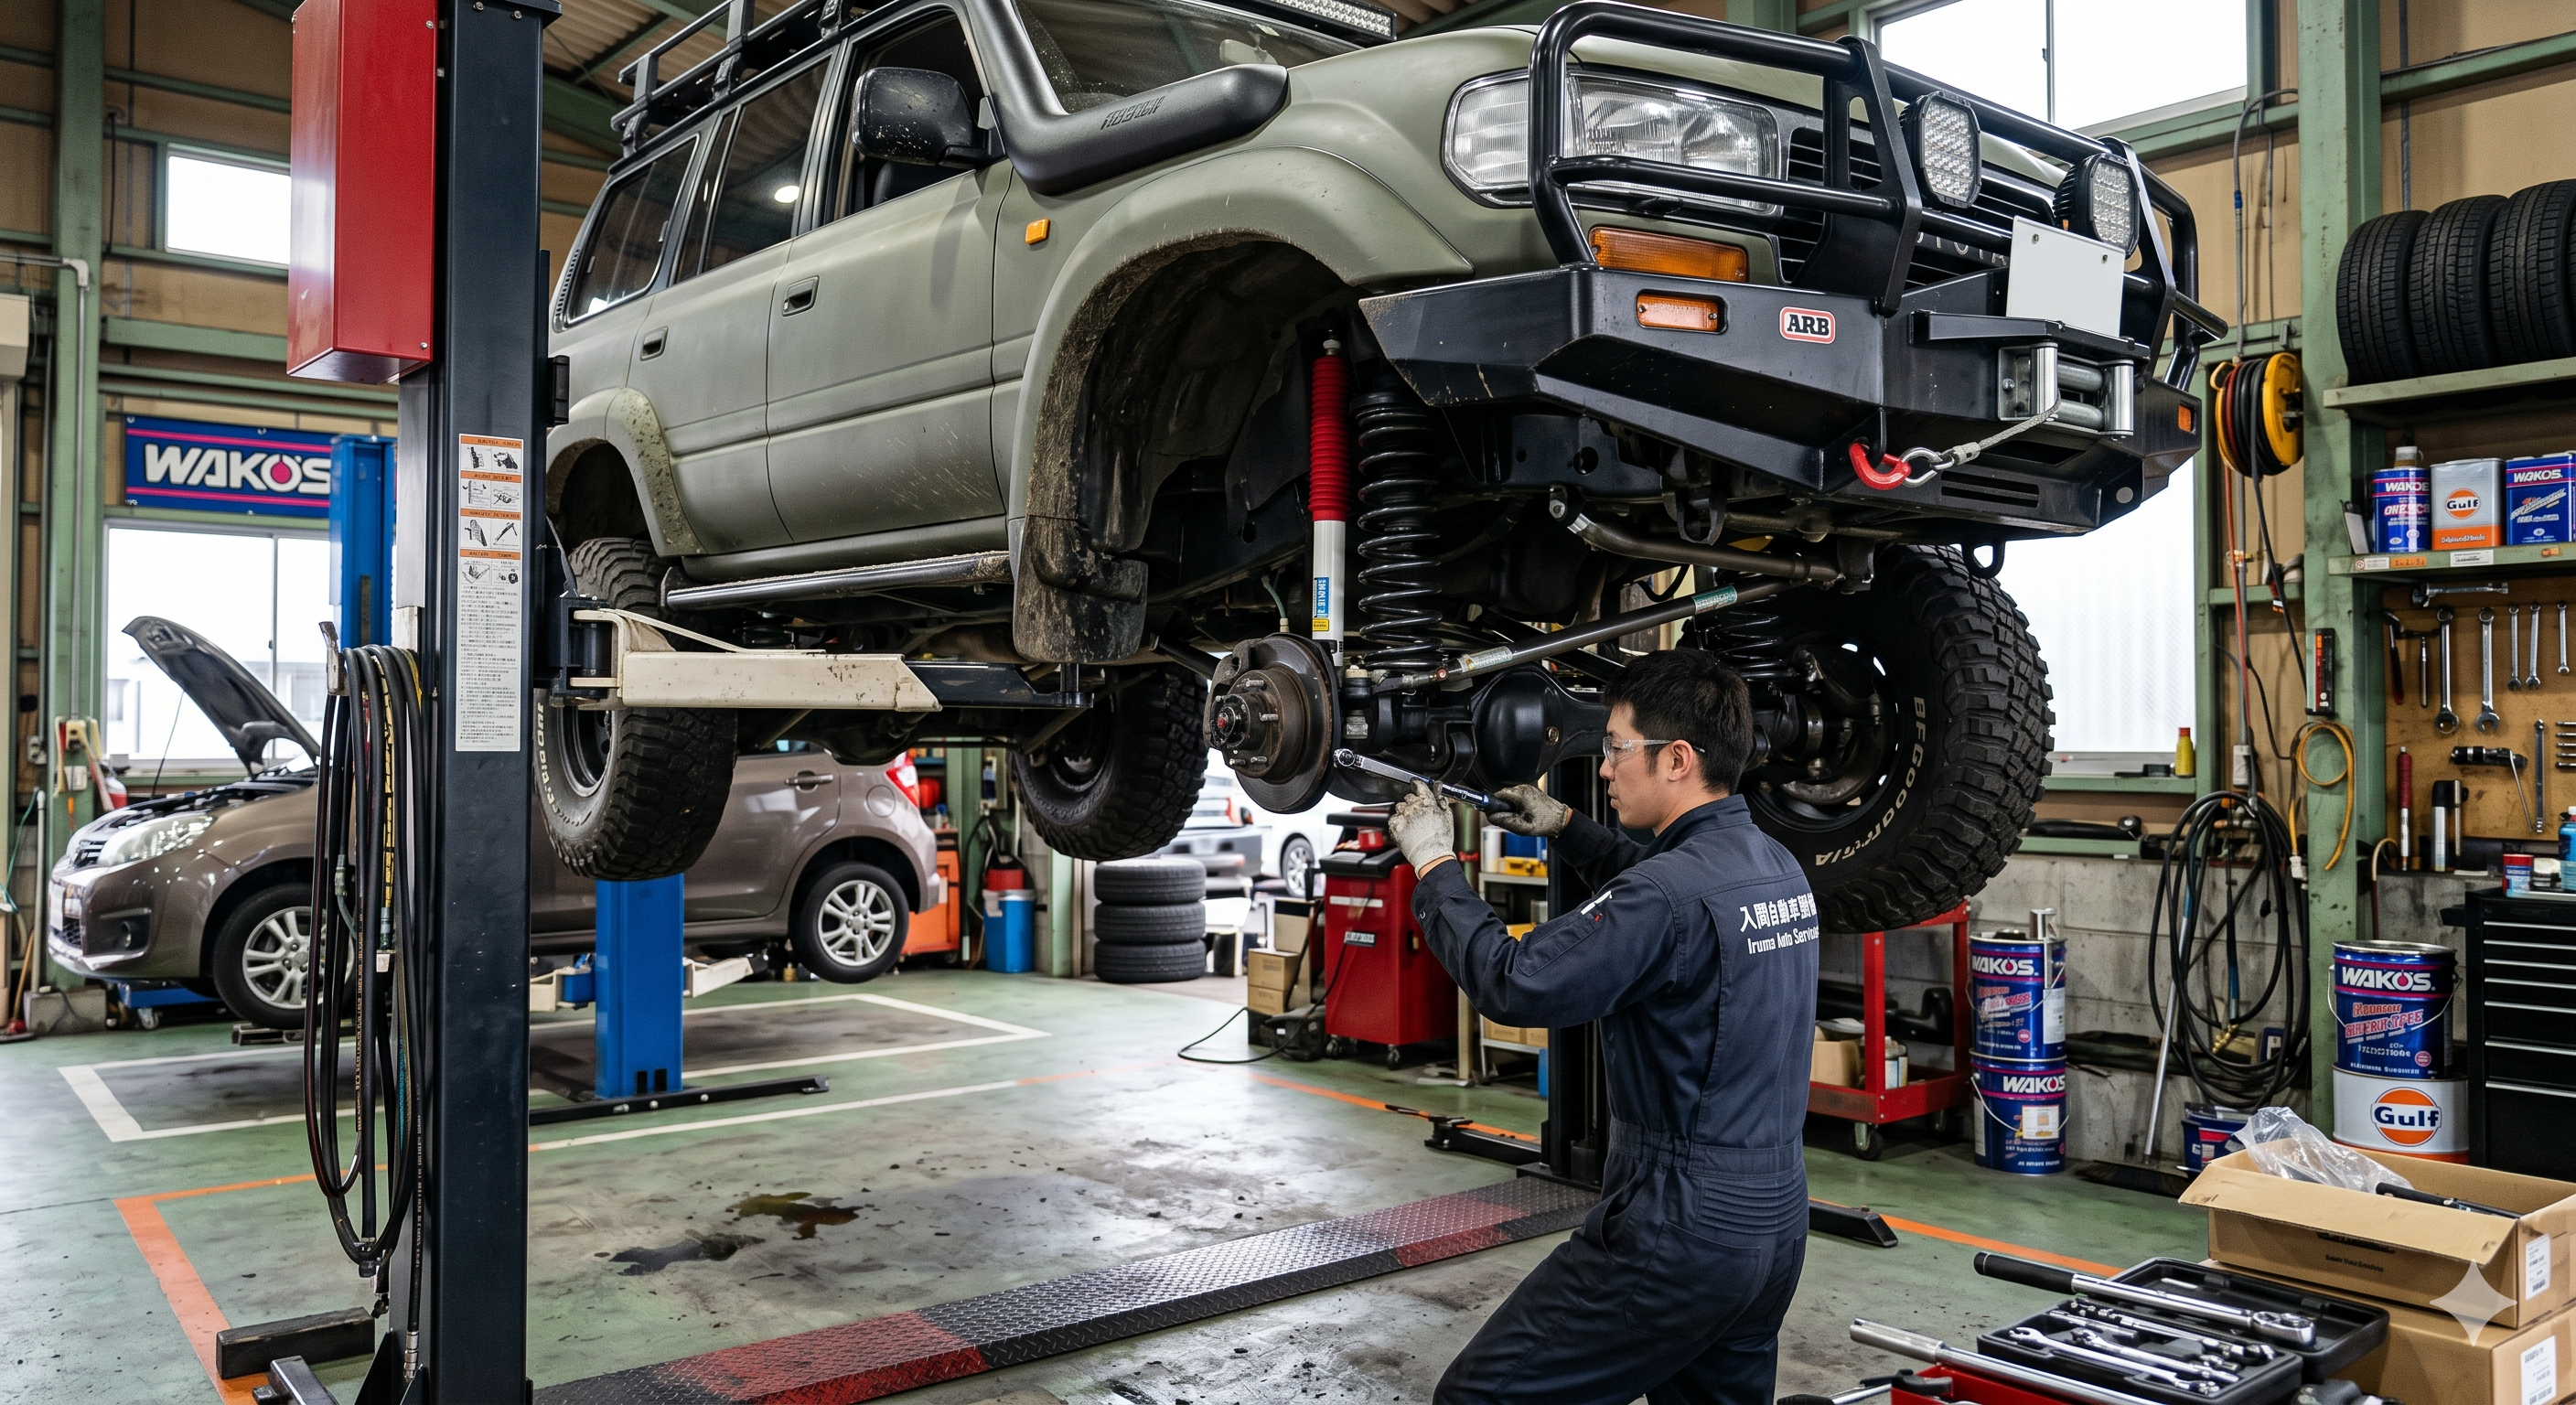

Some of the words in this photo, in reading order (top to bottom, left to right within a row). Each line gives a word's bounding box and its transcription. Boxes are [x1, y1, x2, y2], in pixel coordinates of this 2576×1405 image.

[1787, 314, 1830, 337] ARB
[2446, 499, 2479, 509] Gulf
[1747, 938, 1776, 955] Iruma
[2374, 1106, 2439, 1127] Gulf
